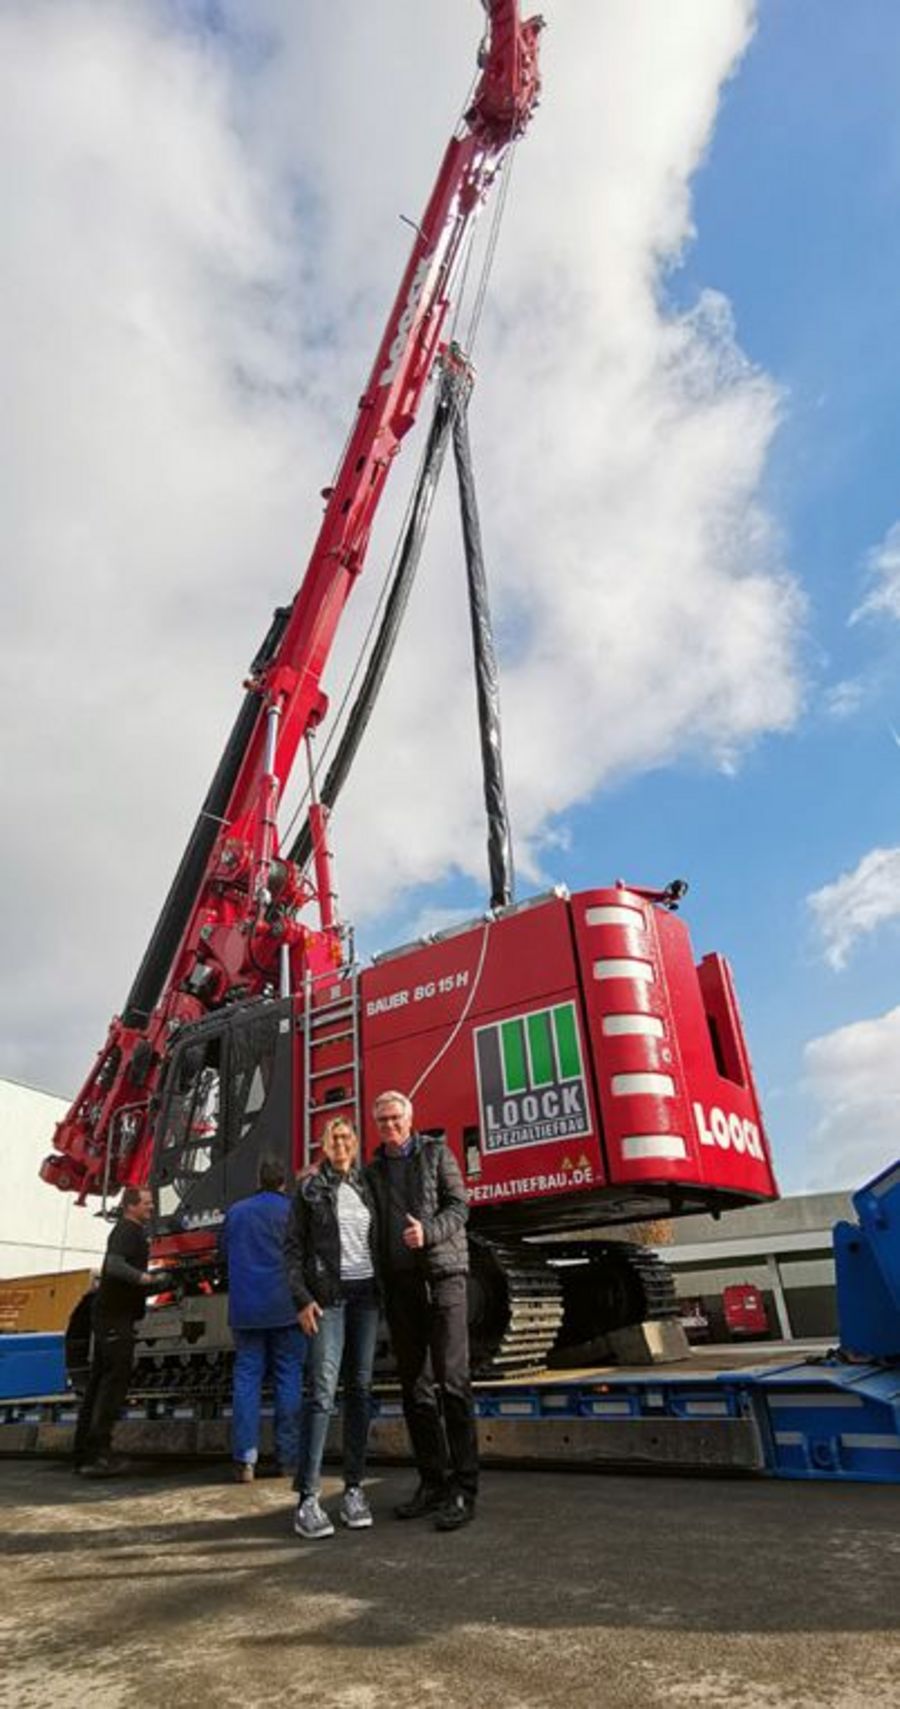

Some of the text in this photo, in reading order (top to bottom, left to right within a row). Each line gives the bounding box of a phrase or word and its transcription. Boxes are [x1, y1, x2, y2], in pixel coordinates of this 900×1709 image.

[366, 970, 469, 1016] BAUER BG 15 H
[486, 1085, 581, 1130] LOOCK
[488, 1117, 585, 1148] SPEZIALTIEFBAU
